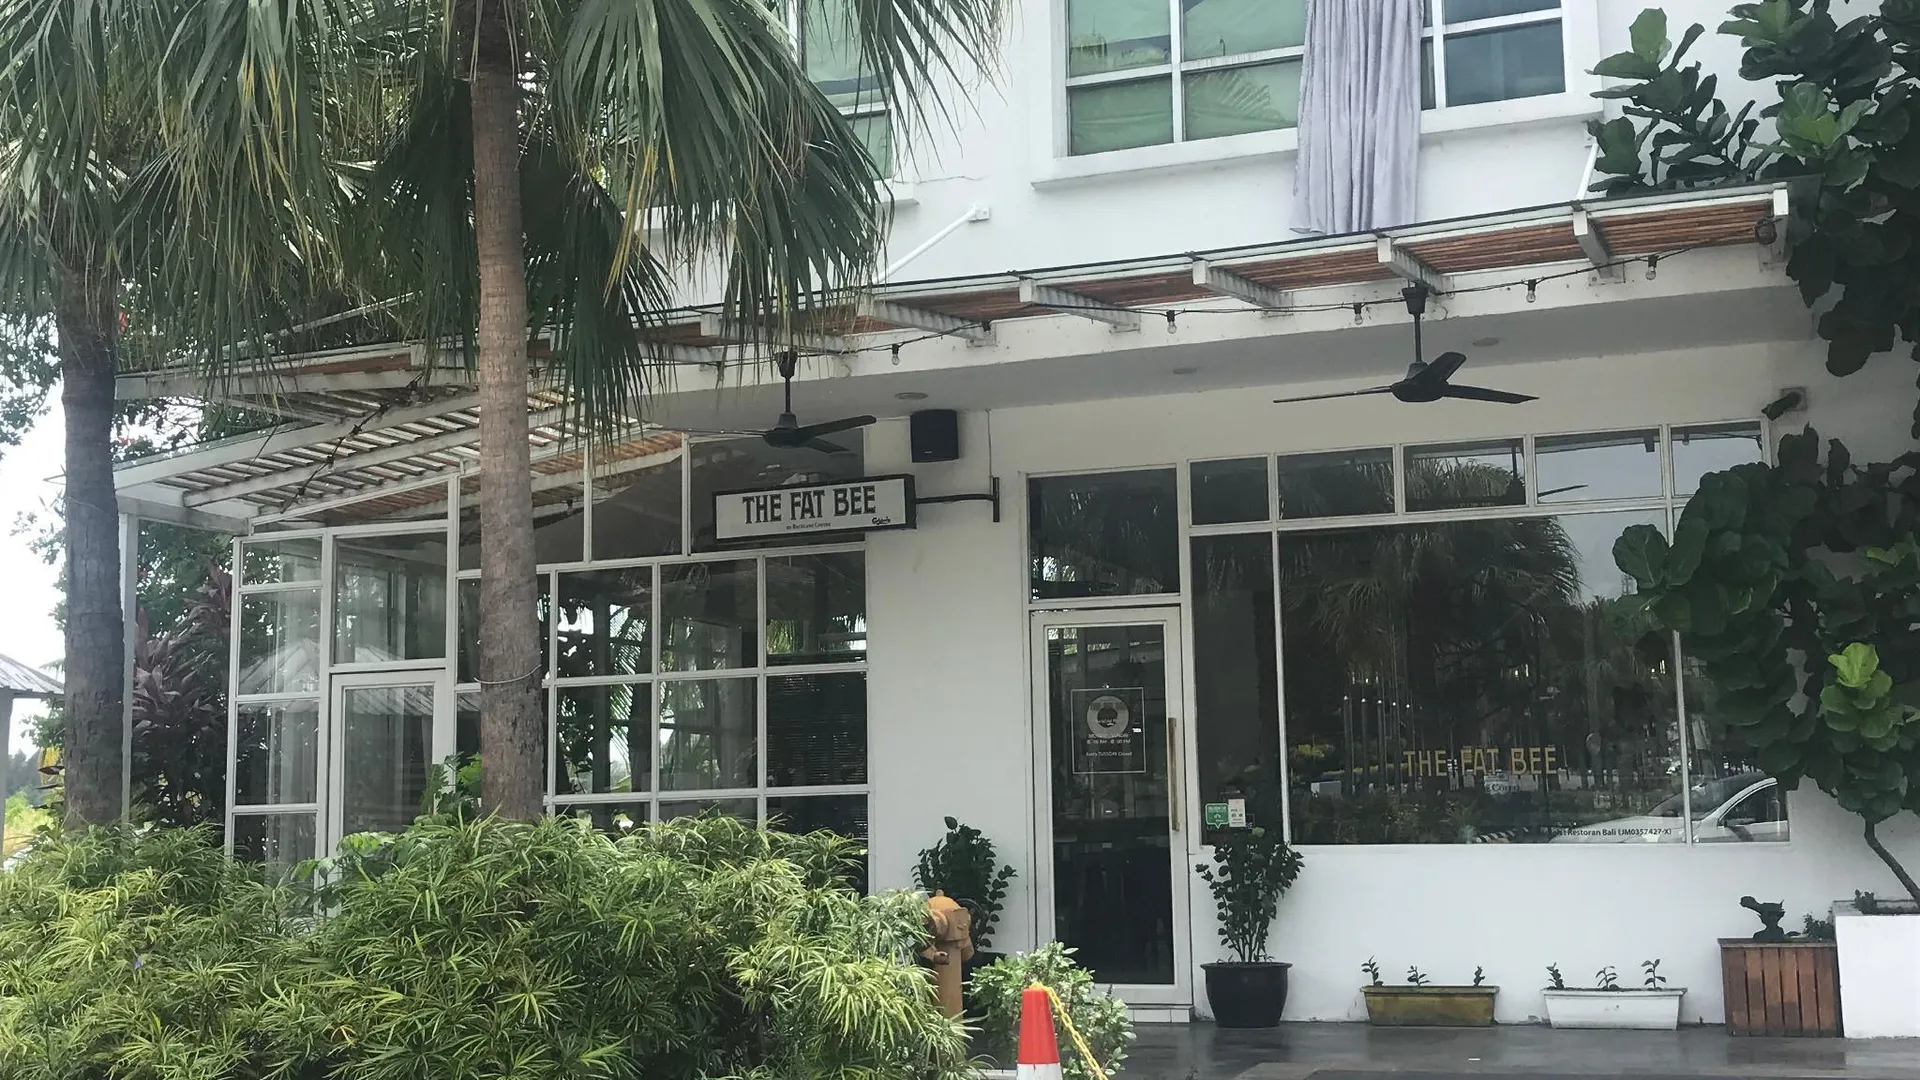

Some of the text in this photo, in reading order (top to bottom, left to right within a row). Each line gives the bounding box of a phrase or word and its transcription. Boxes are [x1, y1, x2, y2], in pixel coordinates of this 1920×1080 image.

[742, 486, 876, 524] THE FAT BEE
[1403, 747, 1557, 777] THE FAT BEE
[1602, 828, 1617, 836] Bali
